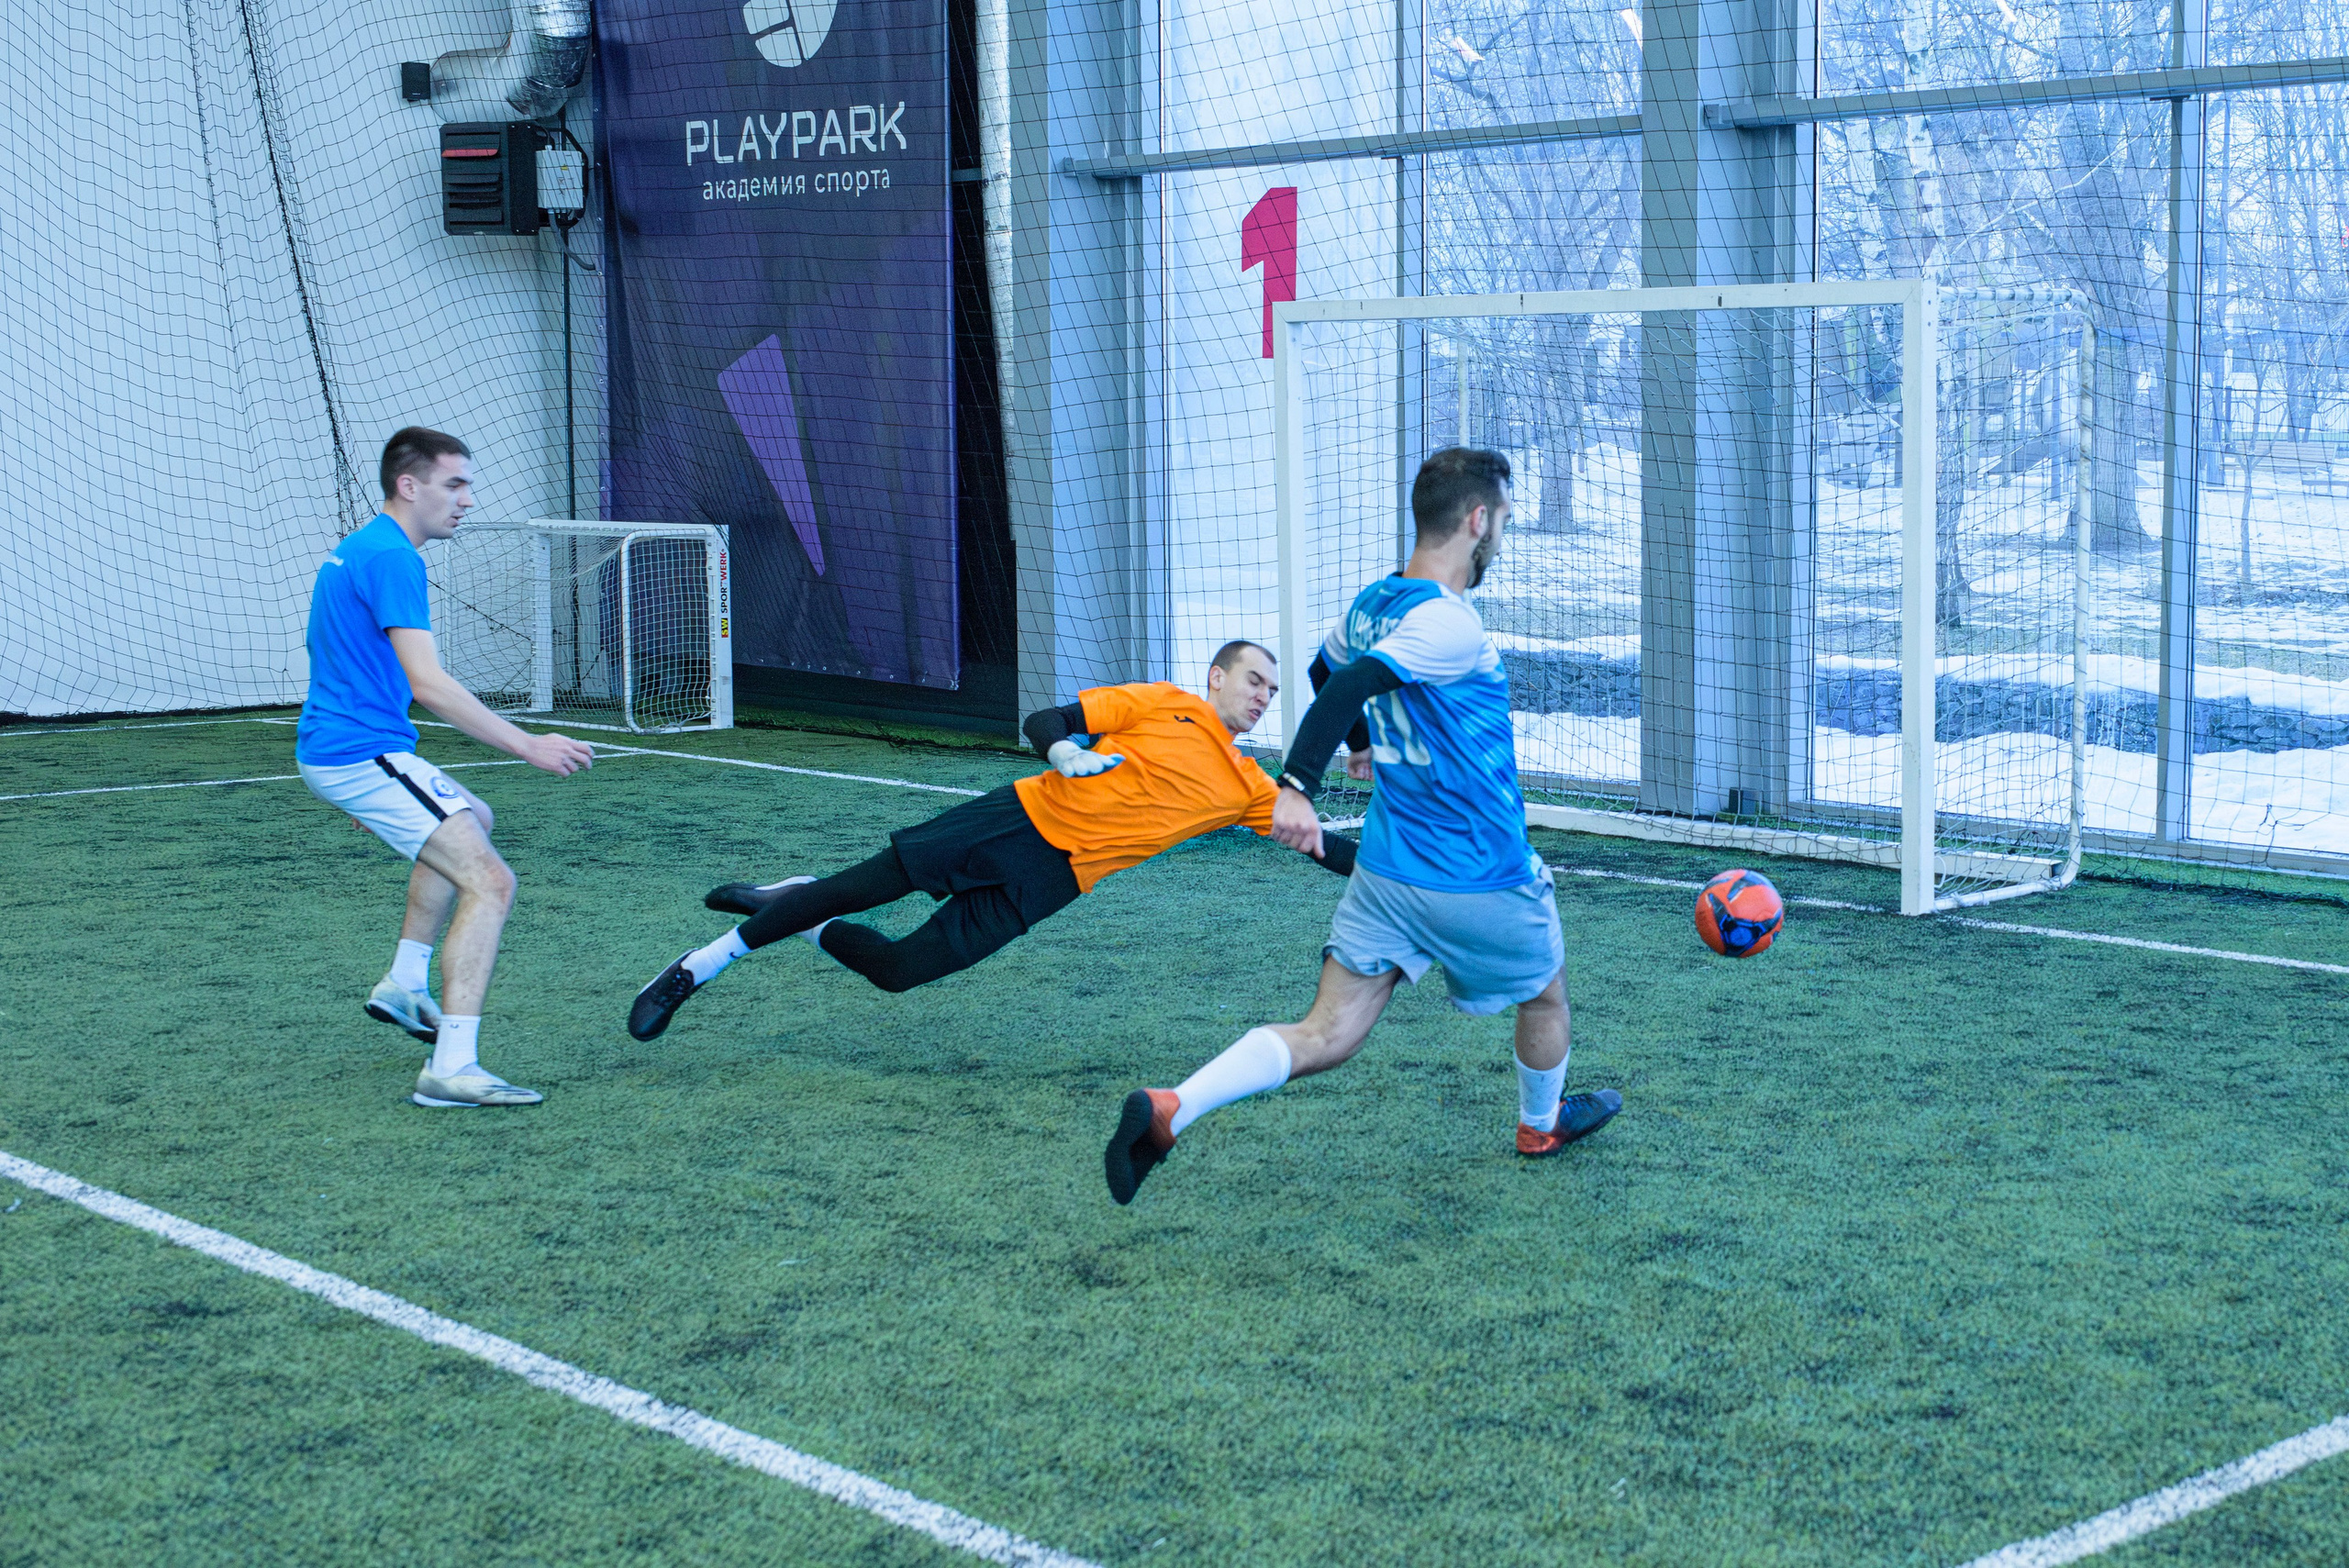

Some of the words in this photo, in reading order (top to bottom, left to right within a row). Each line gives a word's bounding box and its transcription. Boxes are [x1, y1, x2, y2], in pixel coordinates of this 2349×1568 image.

[686, 101, 907, 166] PLAYPARK
[703, 174, 806, 202] академия
[814, 168, 890, 196] спорта
[1241, 186, 1297, 359] 1
